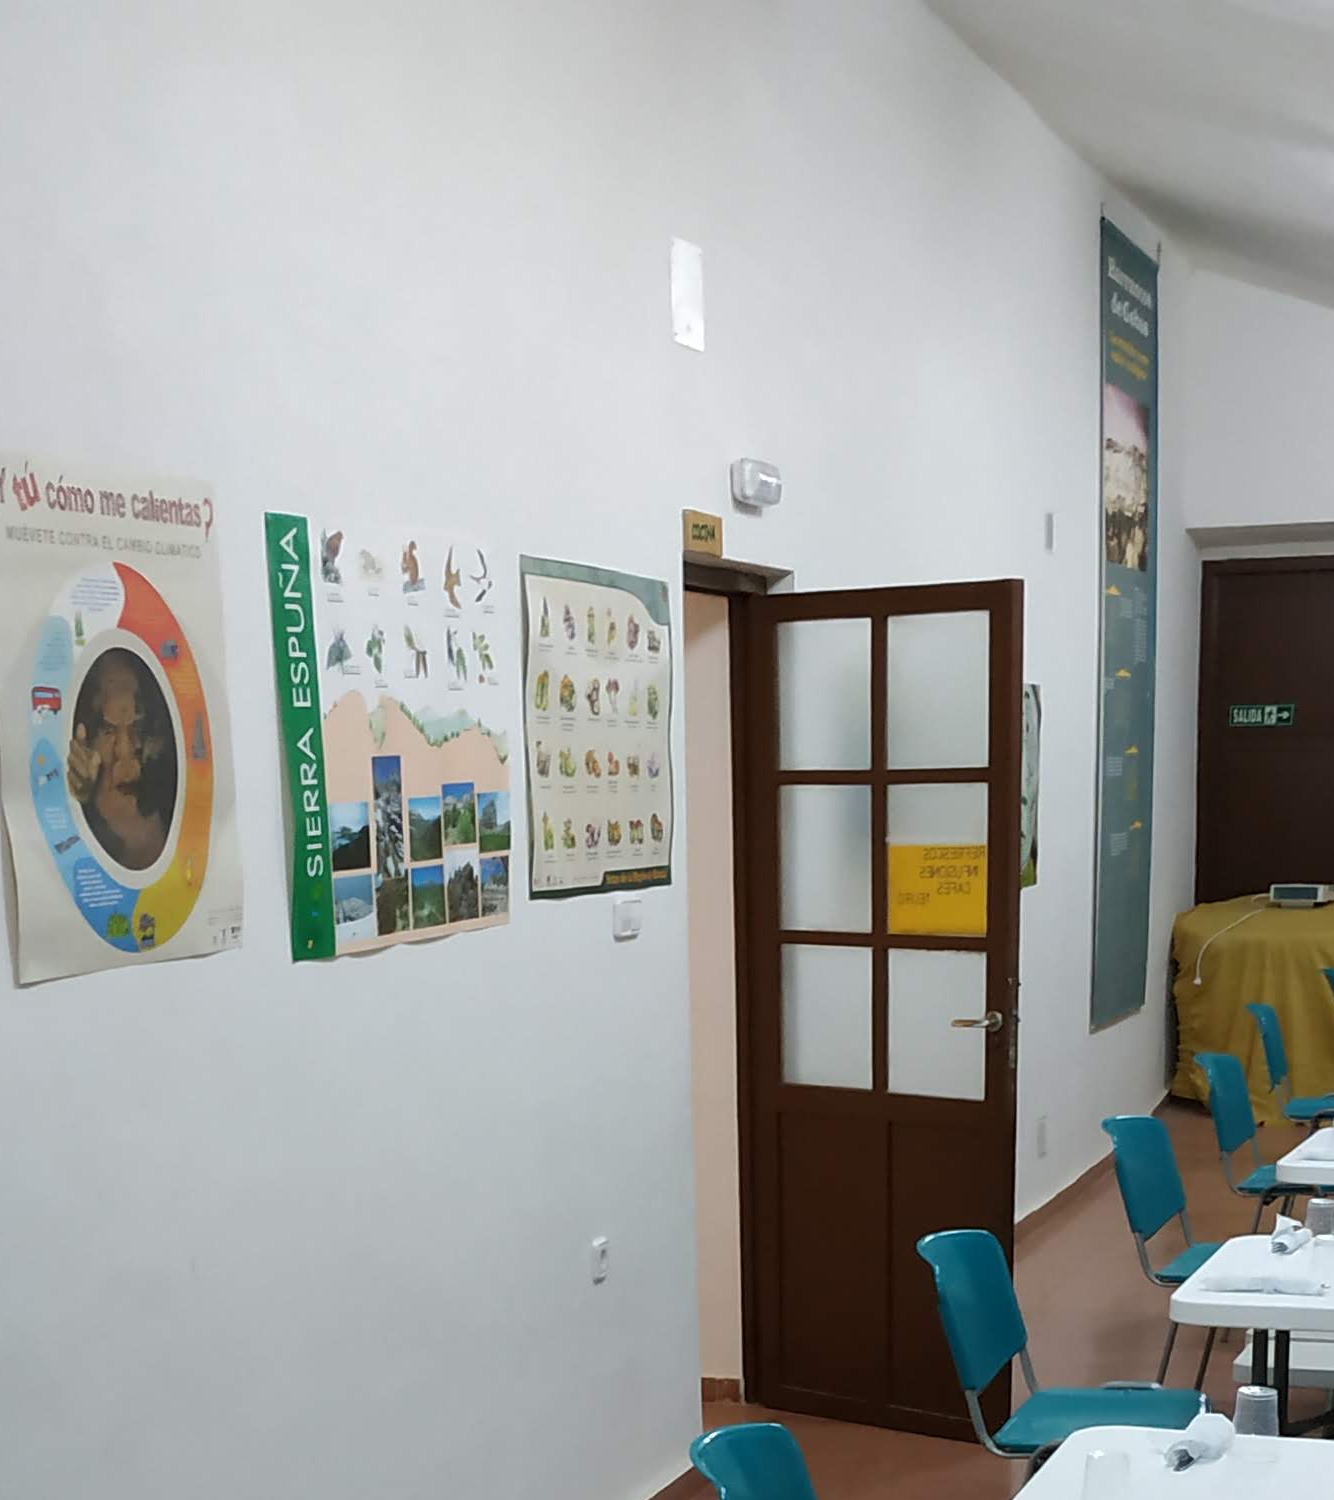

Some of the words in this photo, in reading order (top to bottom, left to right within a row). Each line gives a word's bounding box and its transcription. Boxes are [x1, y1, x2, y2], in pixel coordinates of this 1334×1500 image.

[12, 460, 41, 511] tú
[45, 474, 94, 514] cómo
[99, 489, 126, 518] me
[59, 530, 99, 547] CONTRA
[101, 535, 114, 551] EL
[116, 537, 153, 554] CAMBIO
[278, 527, 312, 708] ESPUÑA
[1233, 709, 1262, 723] SALIDA
[296, 727, 323, 878] SIERRA
